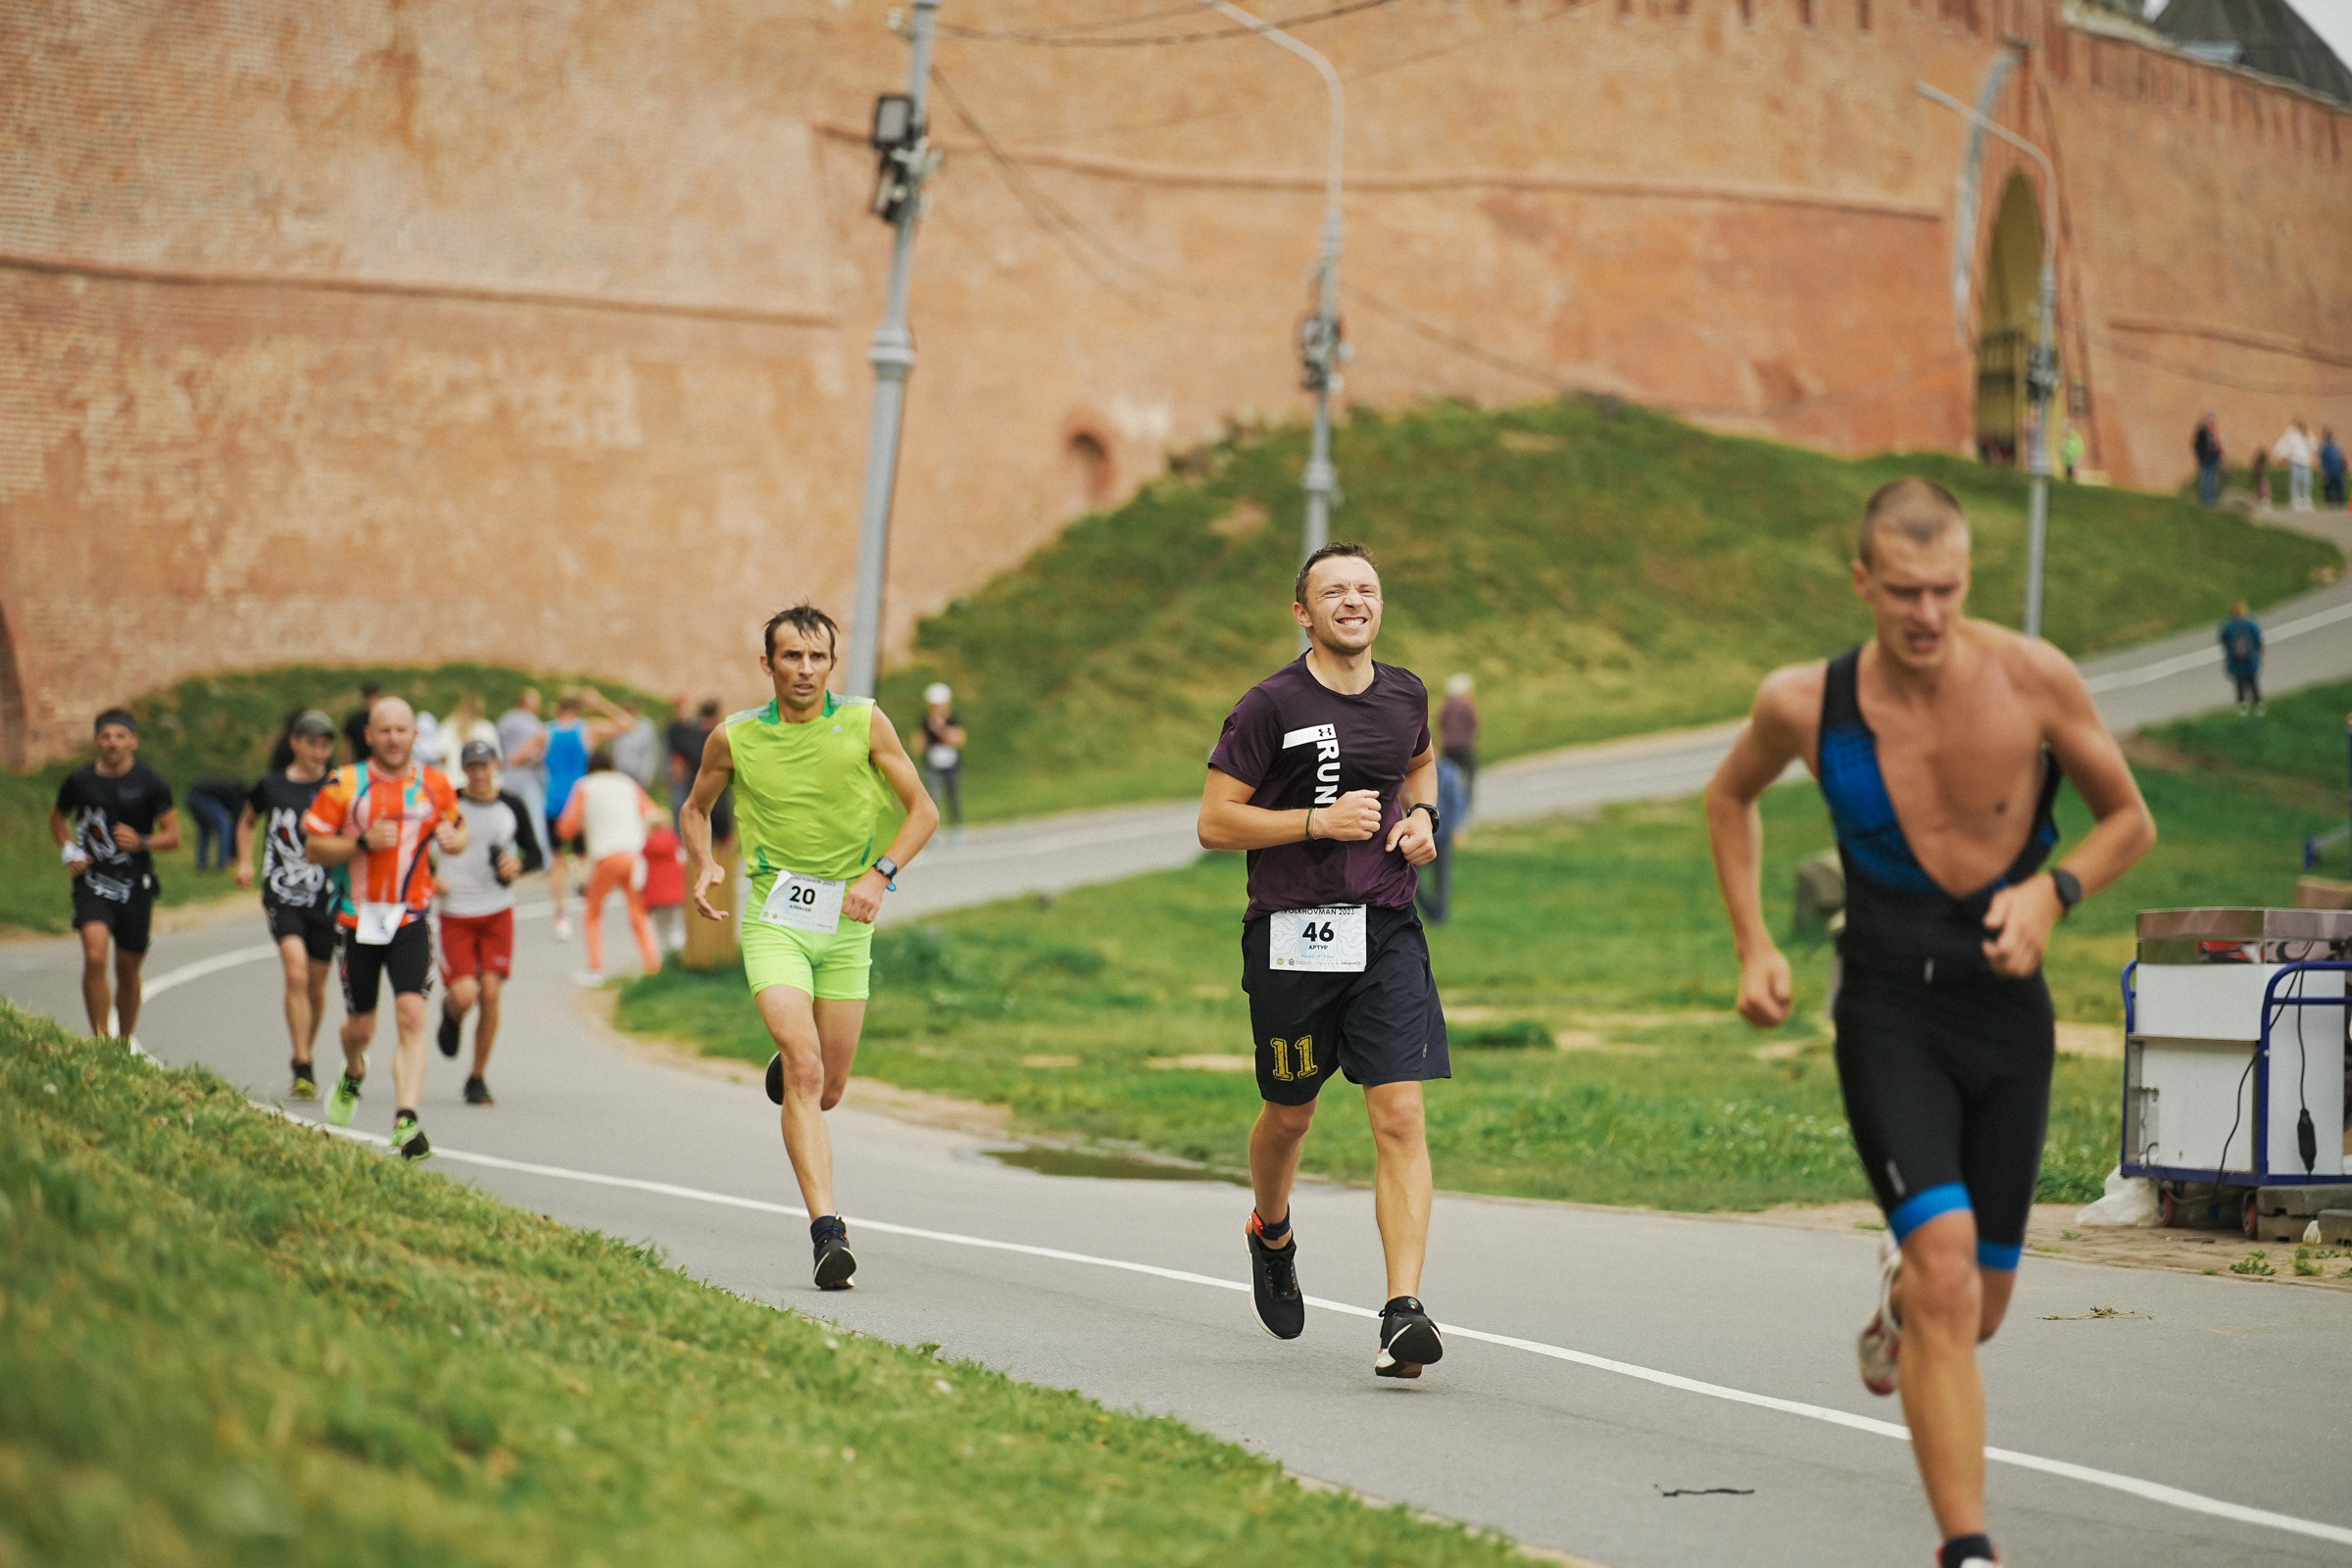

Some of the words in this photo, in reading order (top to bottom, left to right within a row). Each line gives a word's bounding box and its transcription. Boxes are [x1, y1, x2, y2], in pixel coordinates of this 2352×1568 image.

[1314, 739, 1341, 804] RUN
[789, 885, 815, 905] 20
[1302, 921, 1334, 942] 46
[1270, 1034, 1318, 1082] 11
